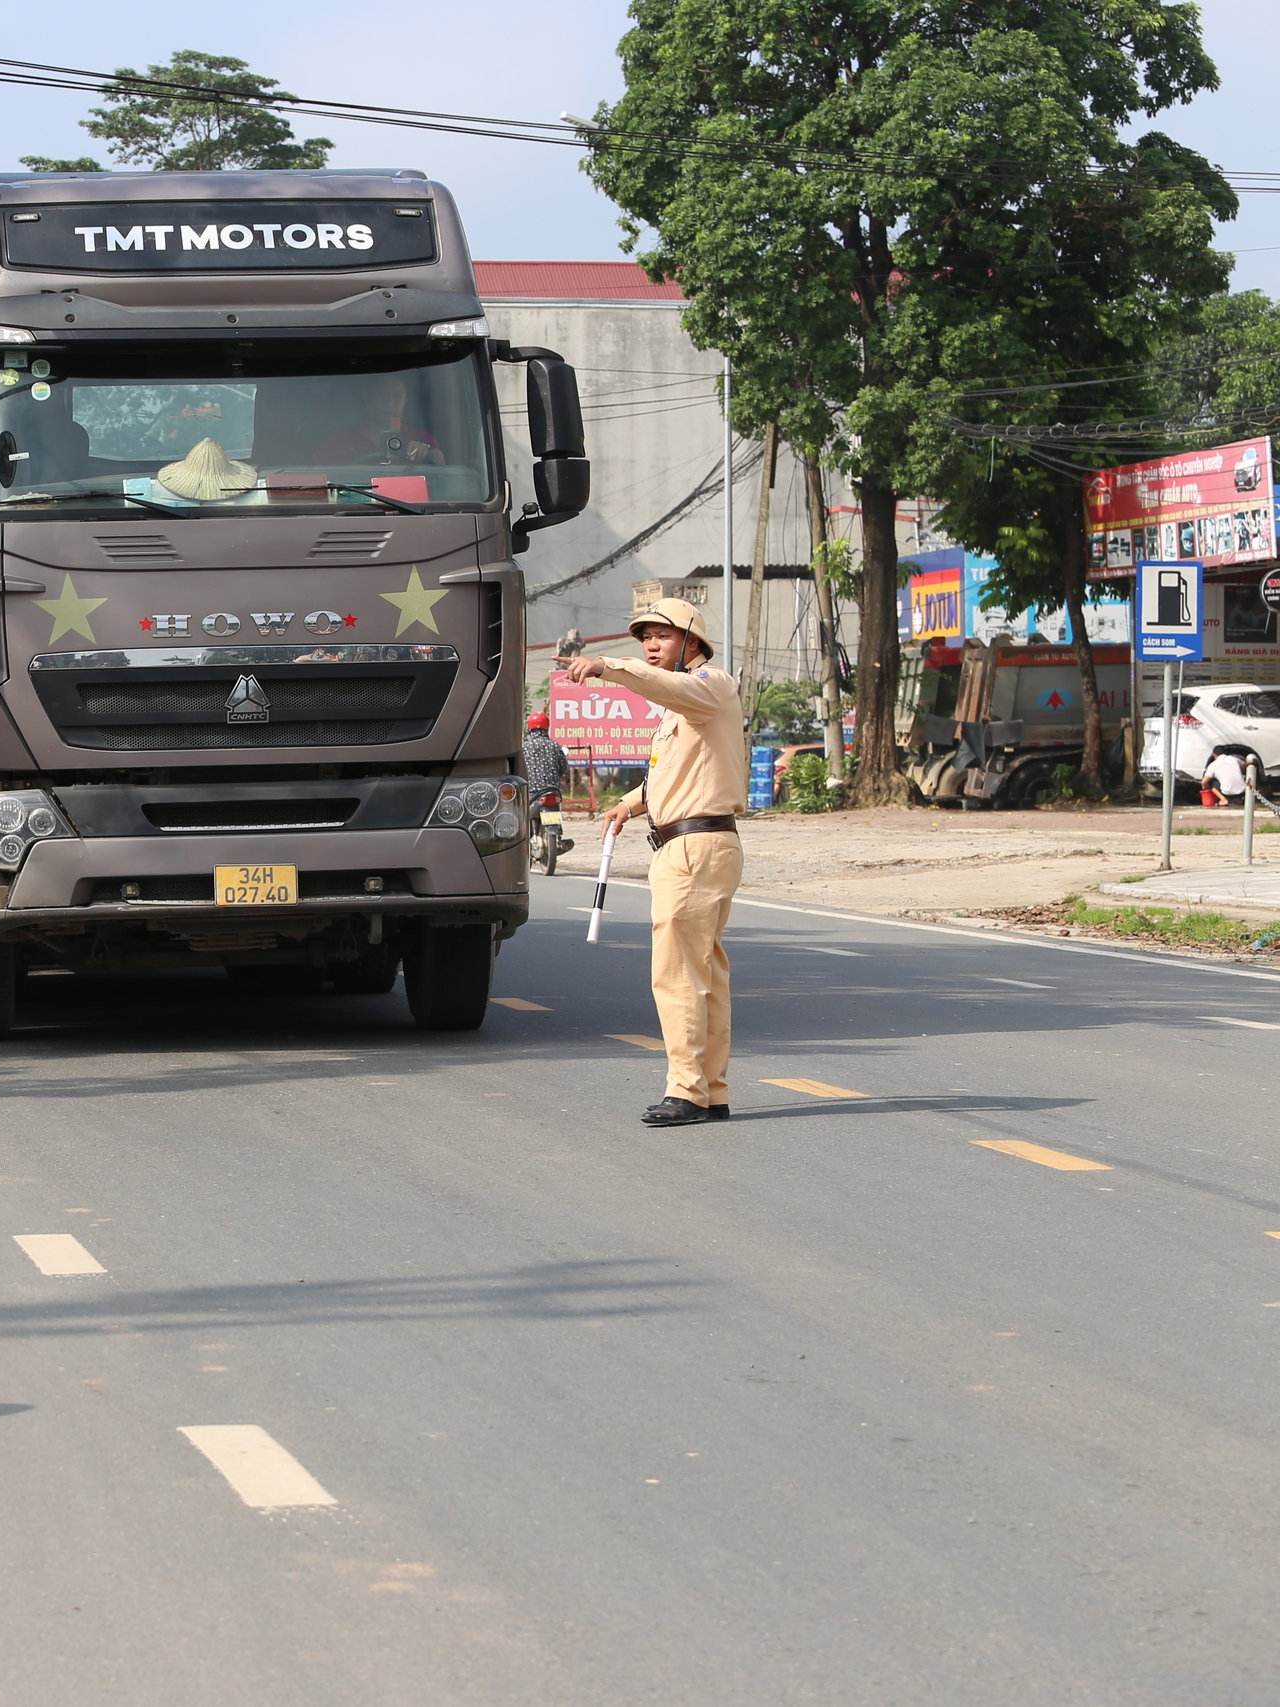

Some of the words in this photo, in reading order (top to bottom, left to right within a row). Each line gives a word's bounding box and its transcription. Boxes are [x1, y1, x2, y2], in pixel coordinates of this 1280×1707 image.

[75, 225, 174, 252] TMT
[180, 223, 374, 250] MOTORS
[924, 591, 958, 632] JOTUN
[152, 610, 343, 638] HOWO
[1142, 636, 1160, 647] CÁCH
[1161, 638, 1175, 647] 50M
[555, 692, 633, 720] RỬA
[230, 711, 266, 721] CNHTC
[593, 725, 604, 739] TÔ
[622, 727, 633, 738] XE
[634, 726, 658, 738] CHUY
[620, 741, 636, 755] RỬA
[239, 867, 274, 885] 34H
[225, 886, 289, 904] 027.40
